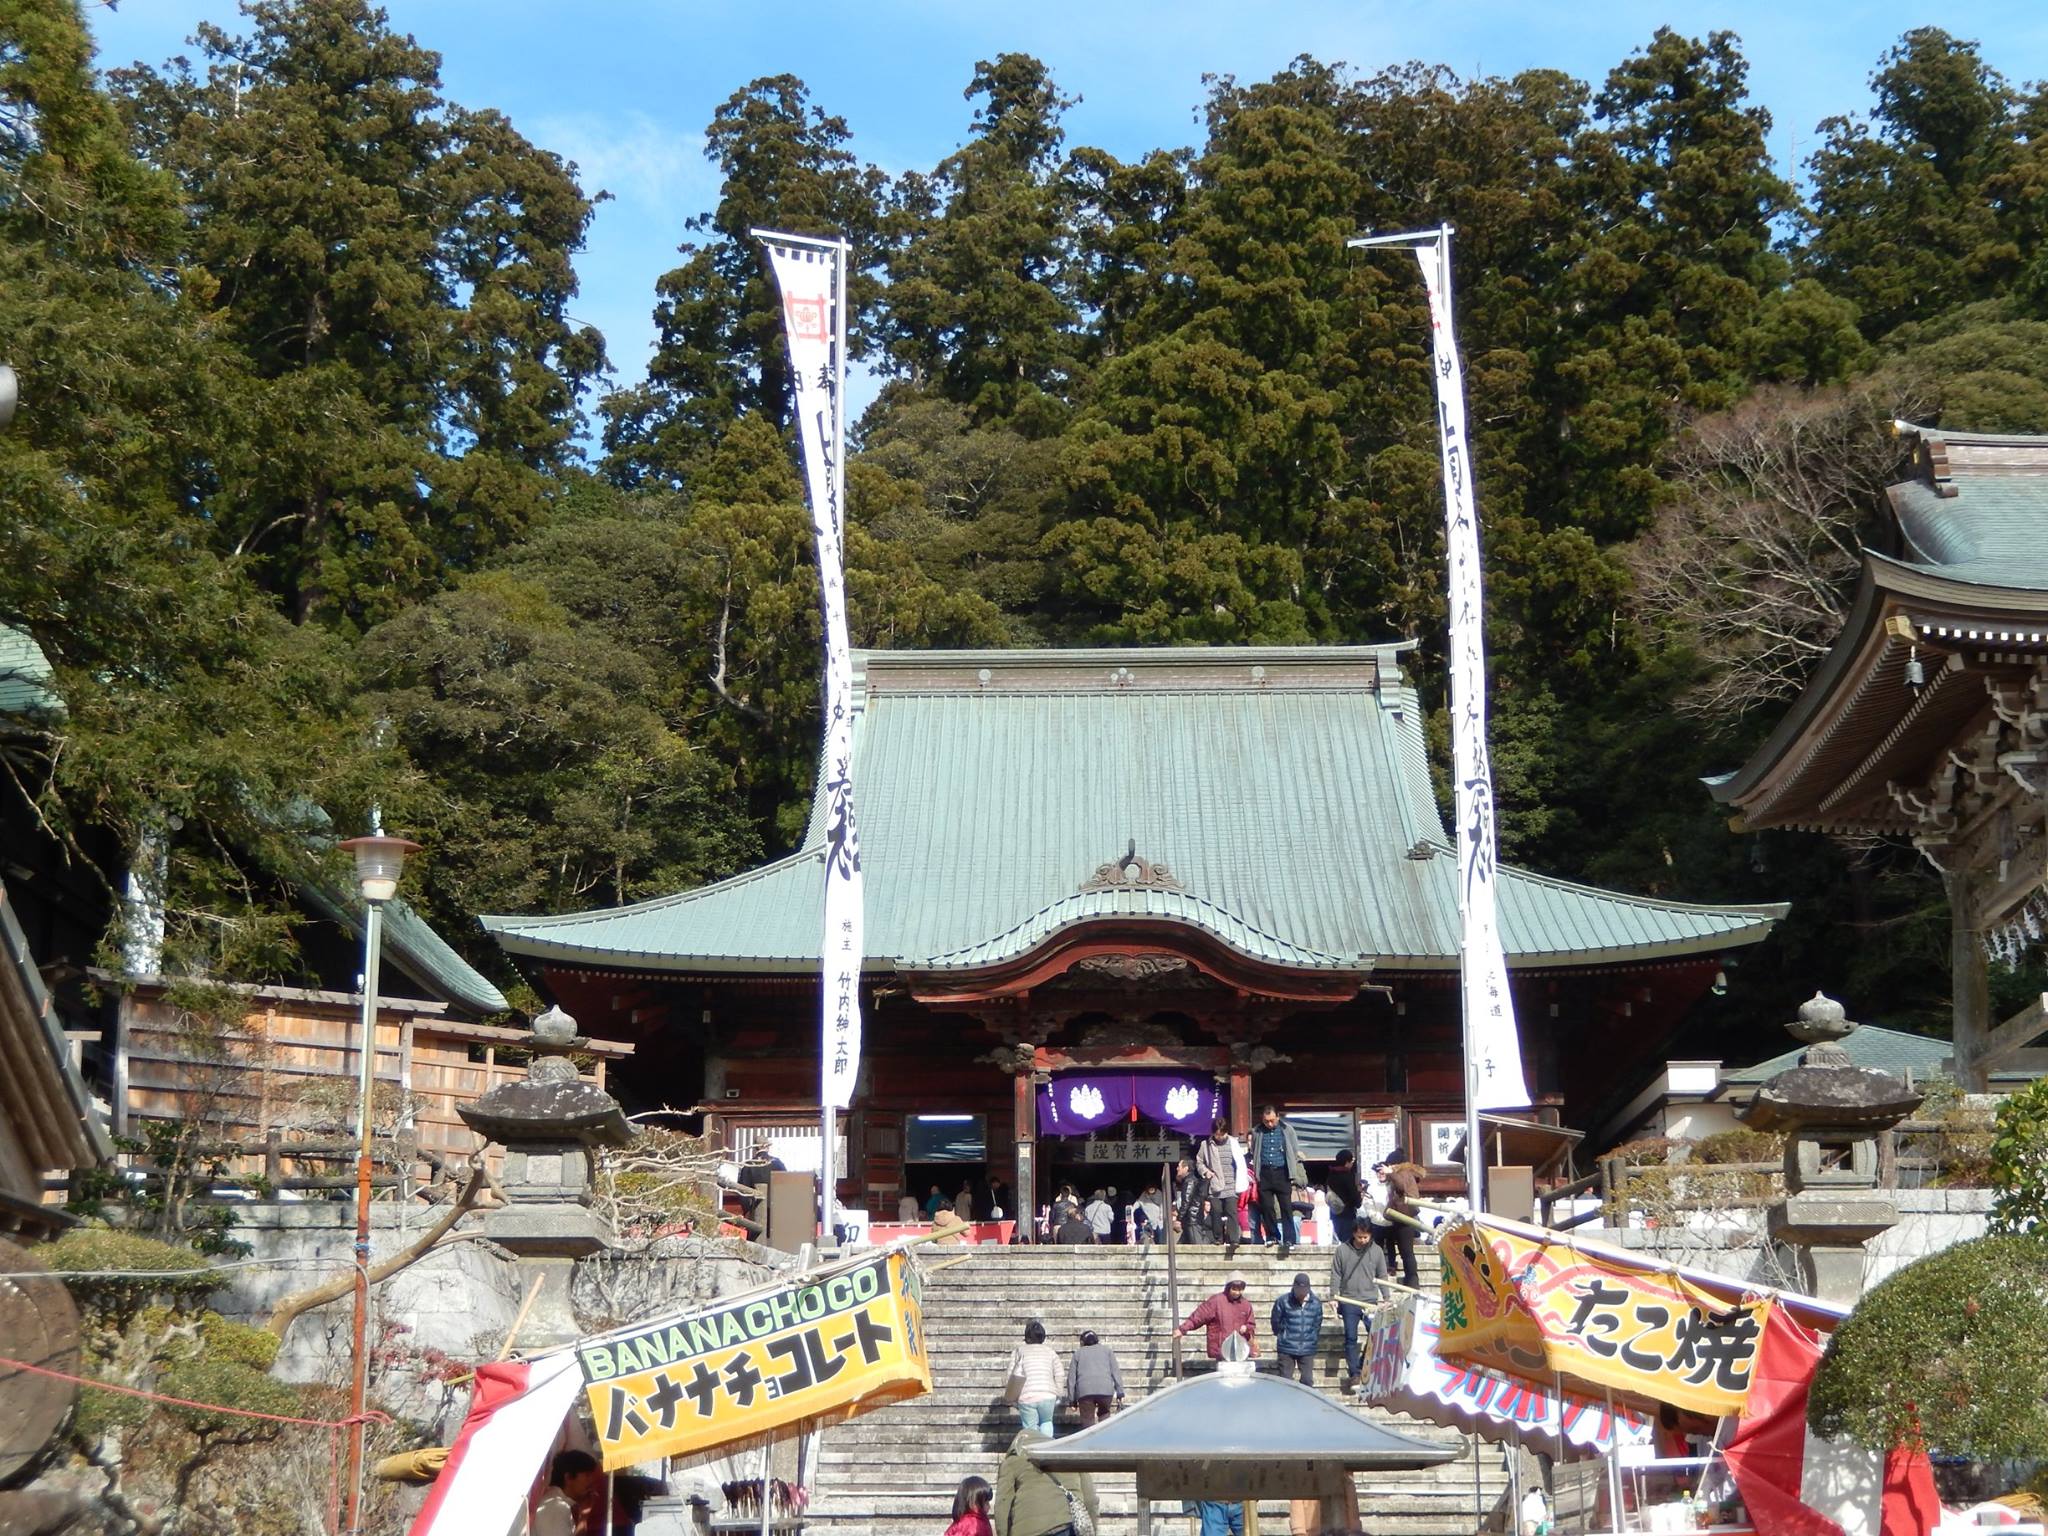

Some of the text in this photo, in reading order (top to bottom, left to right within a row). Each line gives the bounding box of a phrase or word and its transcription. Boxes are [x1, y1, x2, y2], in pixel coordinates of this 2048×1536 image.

[1092, 1143, 1172, 1160] 謹賀新年
[604, 1308, 893, 1442] バナナチョコレート
[1566, 1278, 1761, 1391] たこ焼
